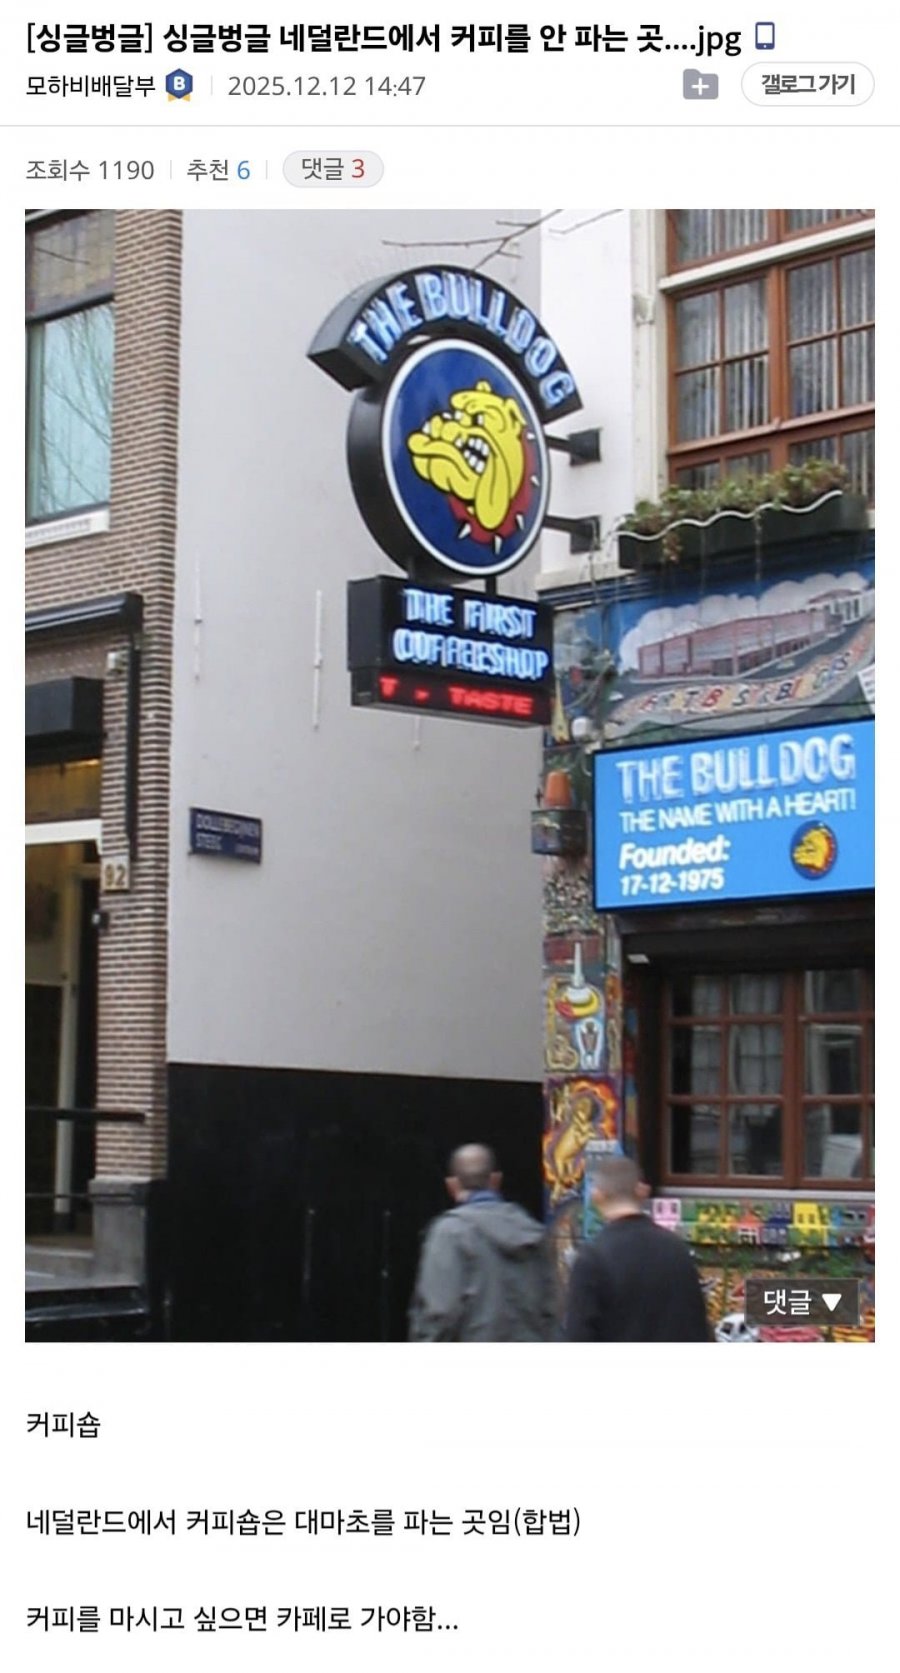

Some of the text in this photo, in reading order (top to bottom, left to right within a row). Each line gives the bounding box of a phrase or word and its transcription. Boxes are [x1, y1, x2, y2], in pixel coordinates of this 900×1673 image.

[347, 272, 574, 409] THE BULLDOG
[403, 588, 537, 639] THE FIRST
[393, 628, 549, 680] COFFEESHOP
[449, 686, 533, 716] TASTE
[616, 733, 856, 804] THE BULLDOG
[620, 788, 857, 834] THE NAME WITH A HEART!
[618, 834, 731, 871] Founded:
[620, 867, 725, 897] 17-12-1975
